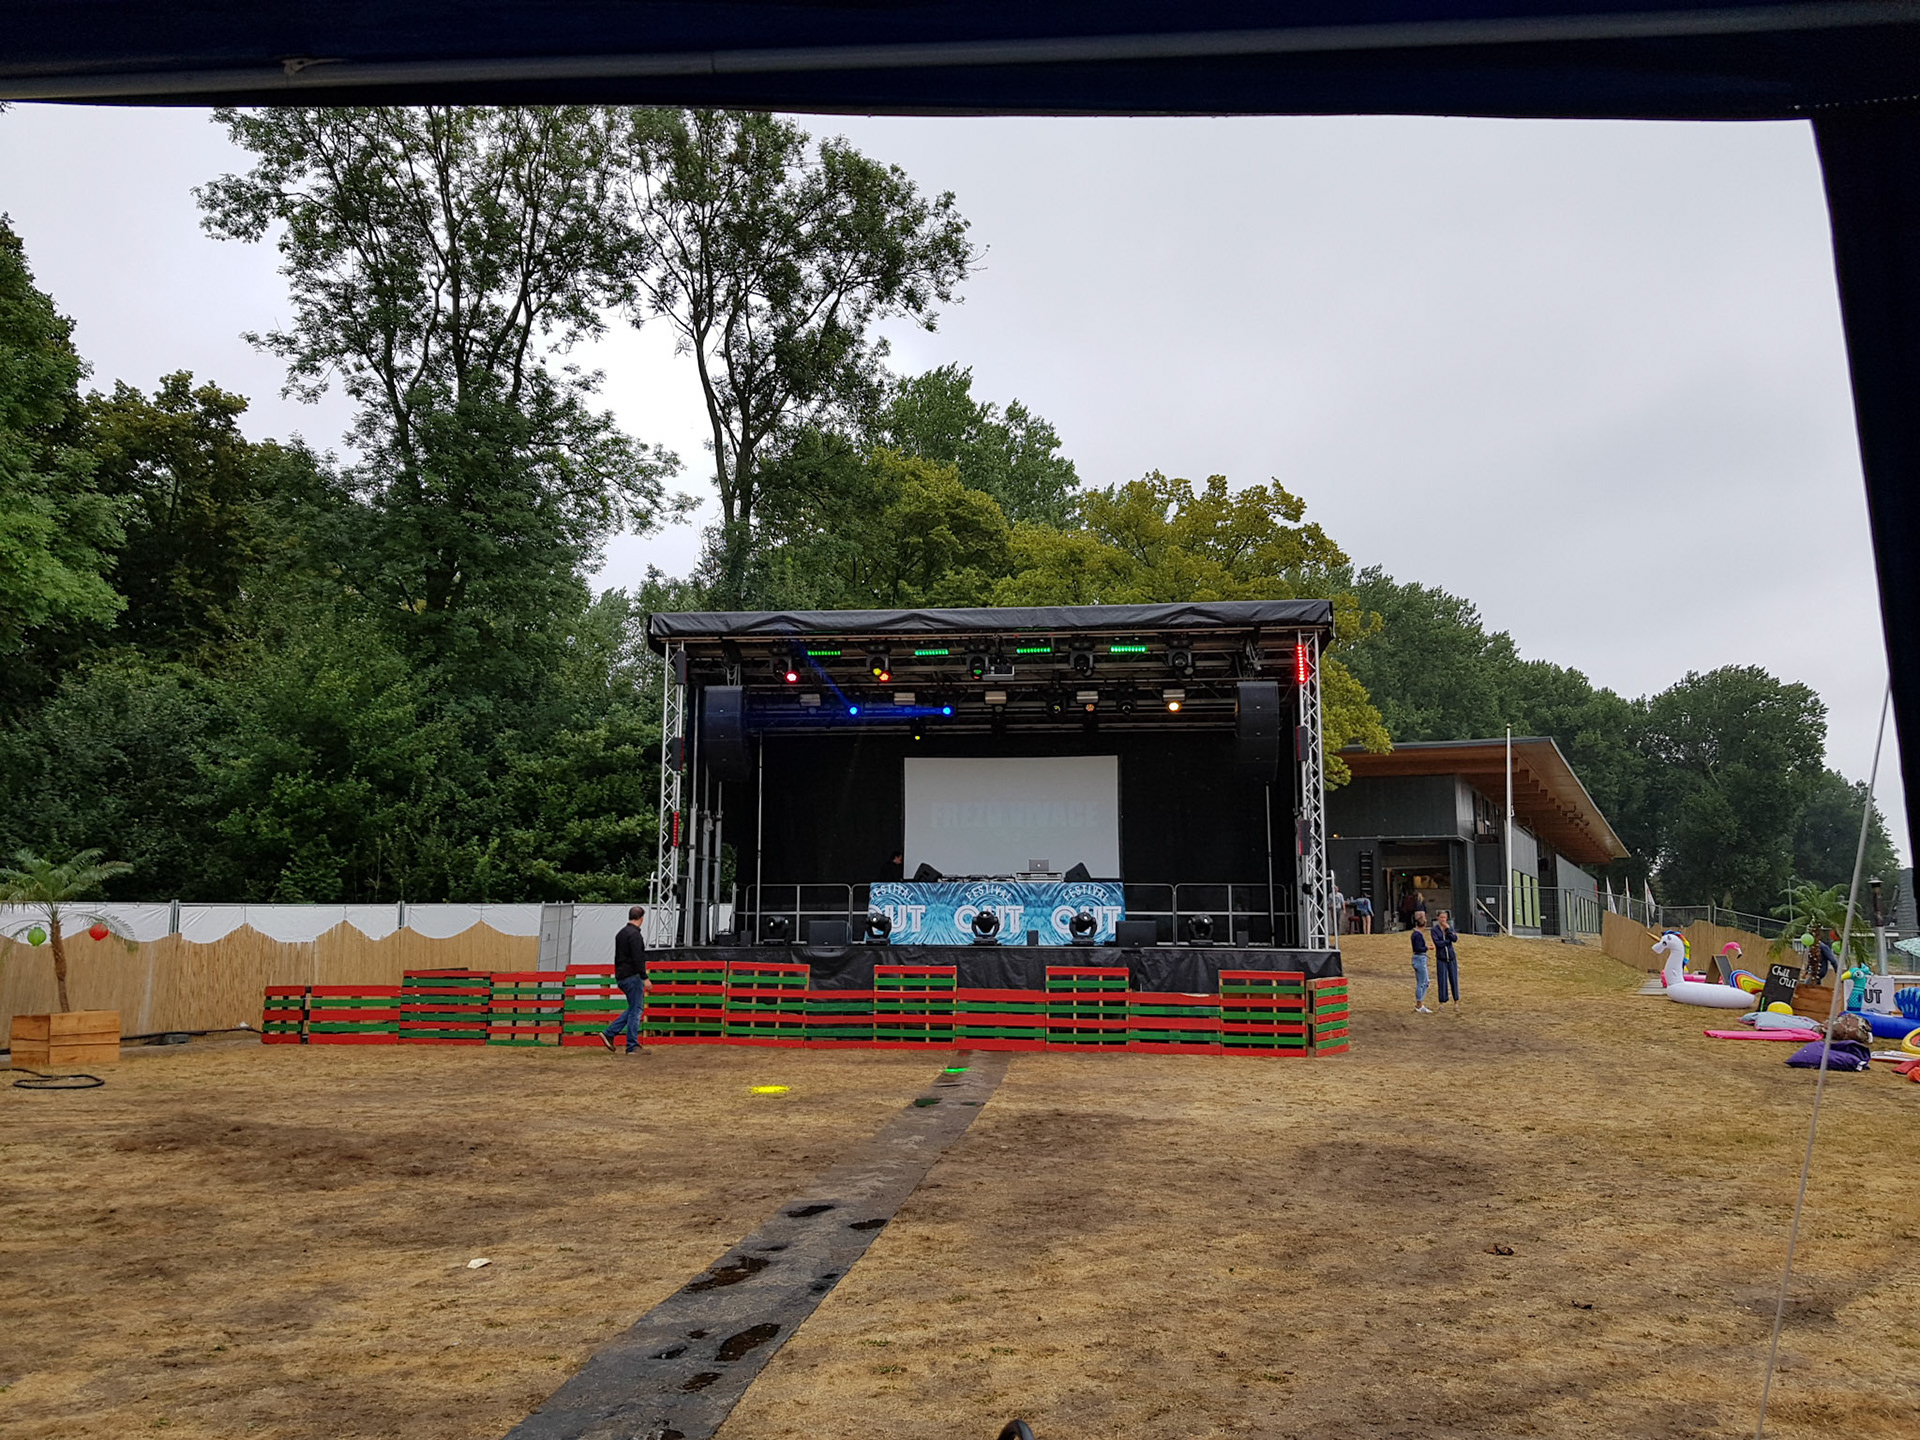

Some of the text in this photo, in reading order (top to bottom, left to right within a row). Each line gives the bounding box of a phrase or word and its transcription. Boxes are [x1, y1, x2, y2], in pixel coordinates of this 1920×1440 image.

[965, 884, 1012, 902] FESTIVAL
[1062, 884, 1110, 902] FESTIVAL
[1863, 988, 1882, 1004] UT
